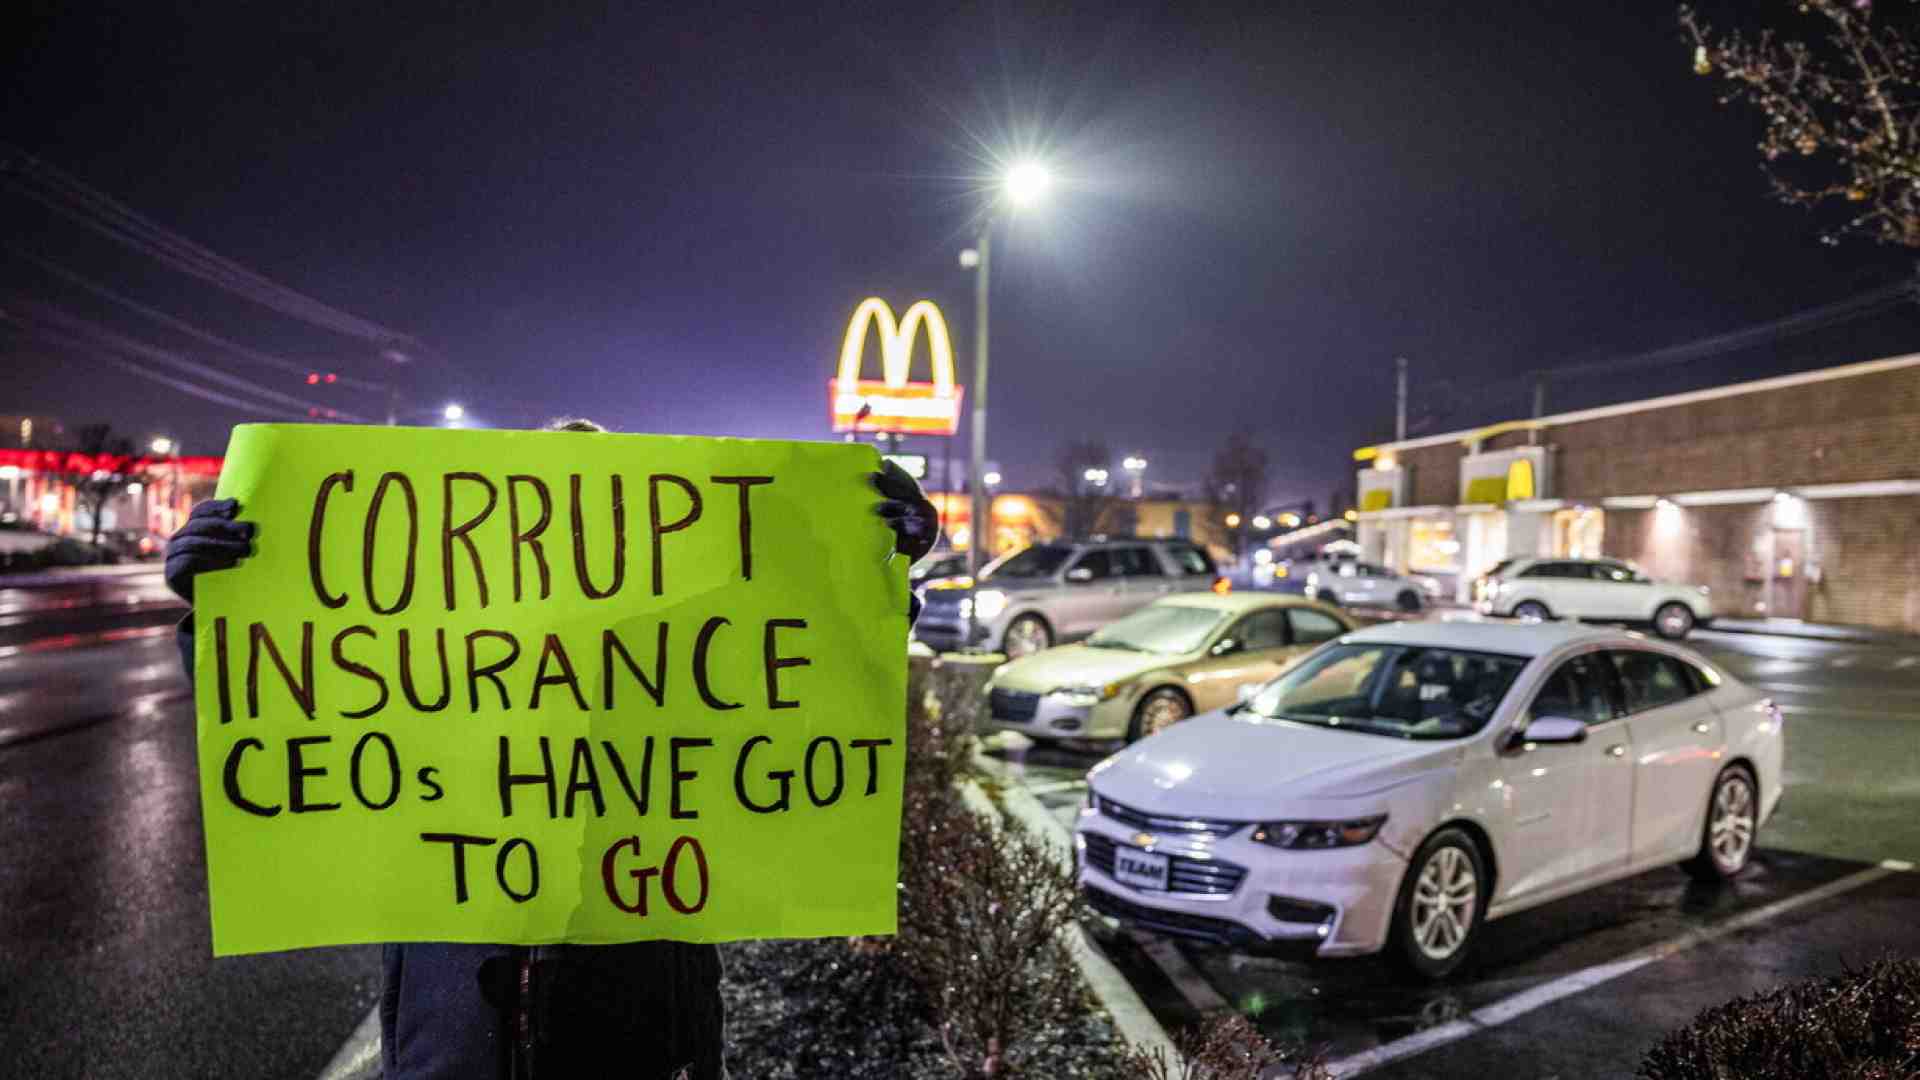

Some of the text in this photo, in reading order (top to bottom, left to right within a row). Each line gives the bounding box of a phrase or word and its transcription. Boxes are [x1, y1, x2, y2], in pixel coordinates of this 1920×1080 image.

[307, 469, 775, 616] CORRUPT
[213, 615, 812, 725] INSURANCE
[497, 734, 715, 820] HAVE
[733, 734, 894, 812] GOT
[419, 832, 710, 919] TO GO
